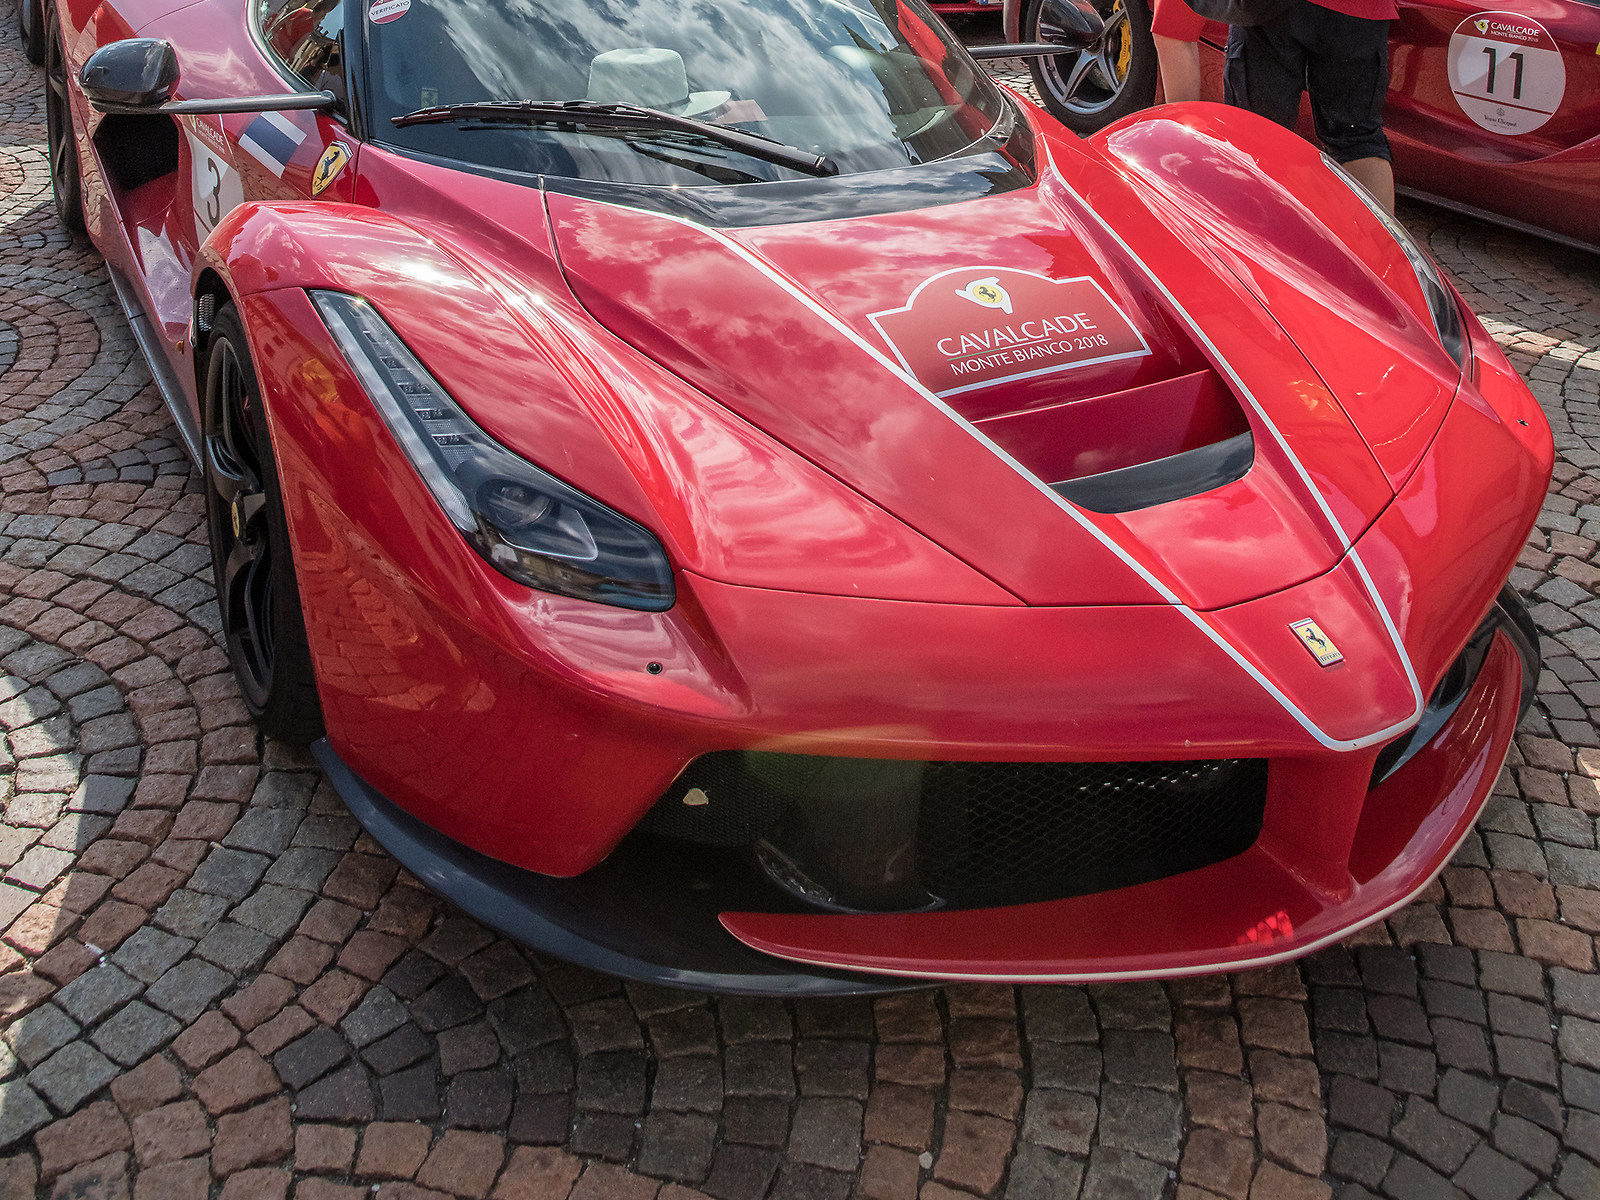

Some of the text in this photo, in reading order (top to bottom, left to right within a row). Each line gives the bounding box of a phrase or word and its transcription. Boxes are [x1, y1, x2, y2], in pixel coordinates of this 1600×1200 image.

[370, 0, 410, 17] VERIFICATO
[1490, 22, 1540, 37] CAVALCADE
[1490, 30, 1508, 38] MONTE
[1508, 33, 1528, 41] BIANCO
[1482, 46, 1525, 100] 11
[207, 157, 221, 228] 3
[936, 312, 1098, 357] CAVALCADE
[950, 333, 1109, 376] MONTE BIANCO 2018
